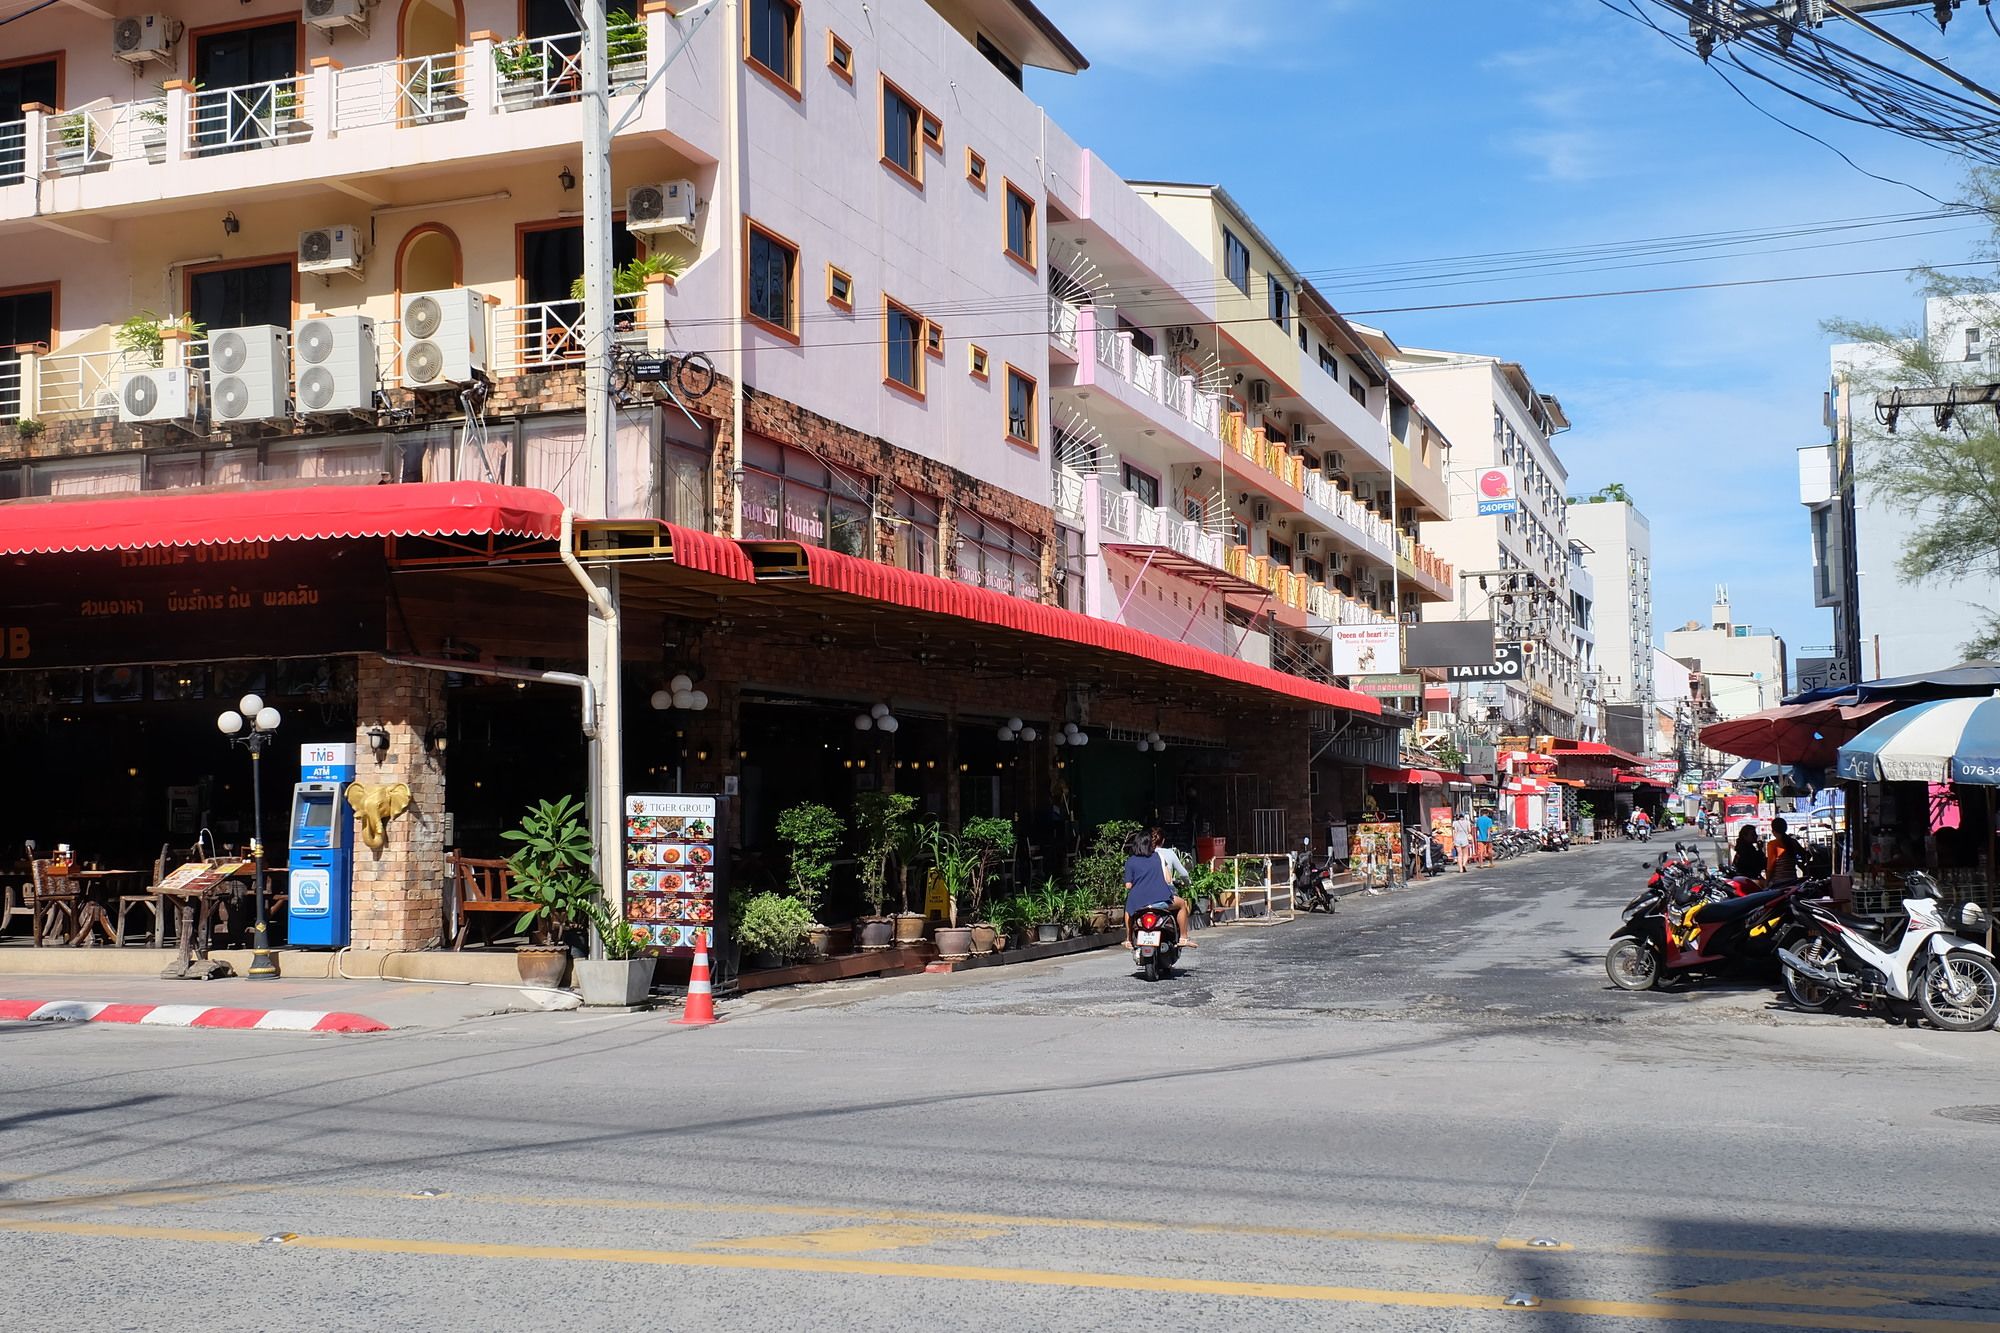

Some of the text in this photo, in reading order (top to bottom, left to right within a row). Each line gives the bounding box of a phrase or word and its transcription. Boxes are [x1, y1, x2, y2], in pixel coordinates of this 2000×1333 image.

[310, 751, 334, 762] TMB
[313, 768, 330, 776] ATM
[650, 803, 711, 814] TIGER GROUP
